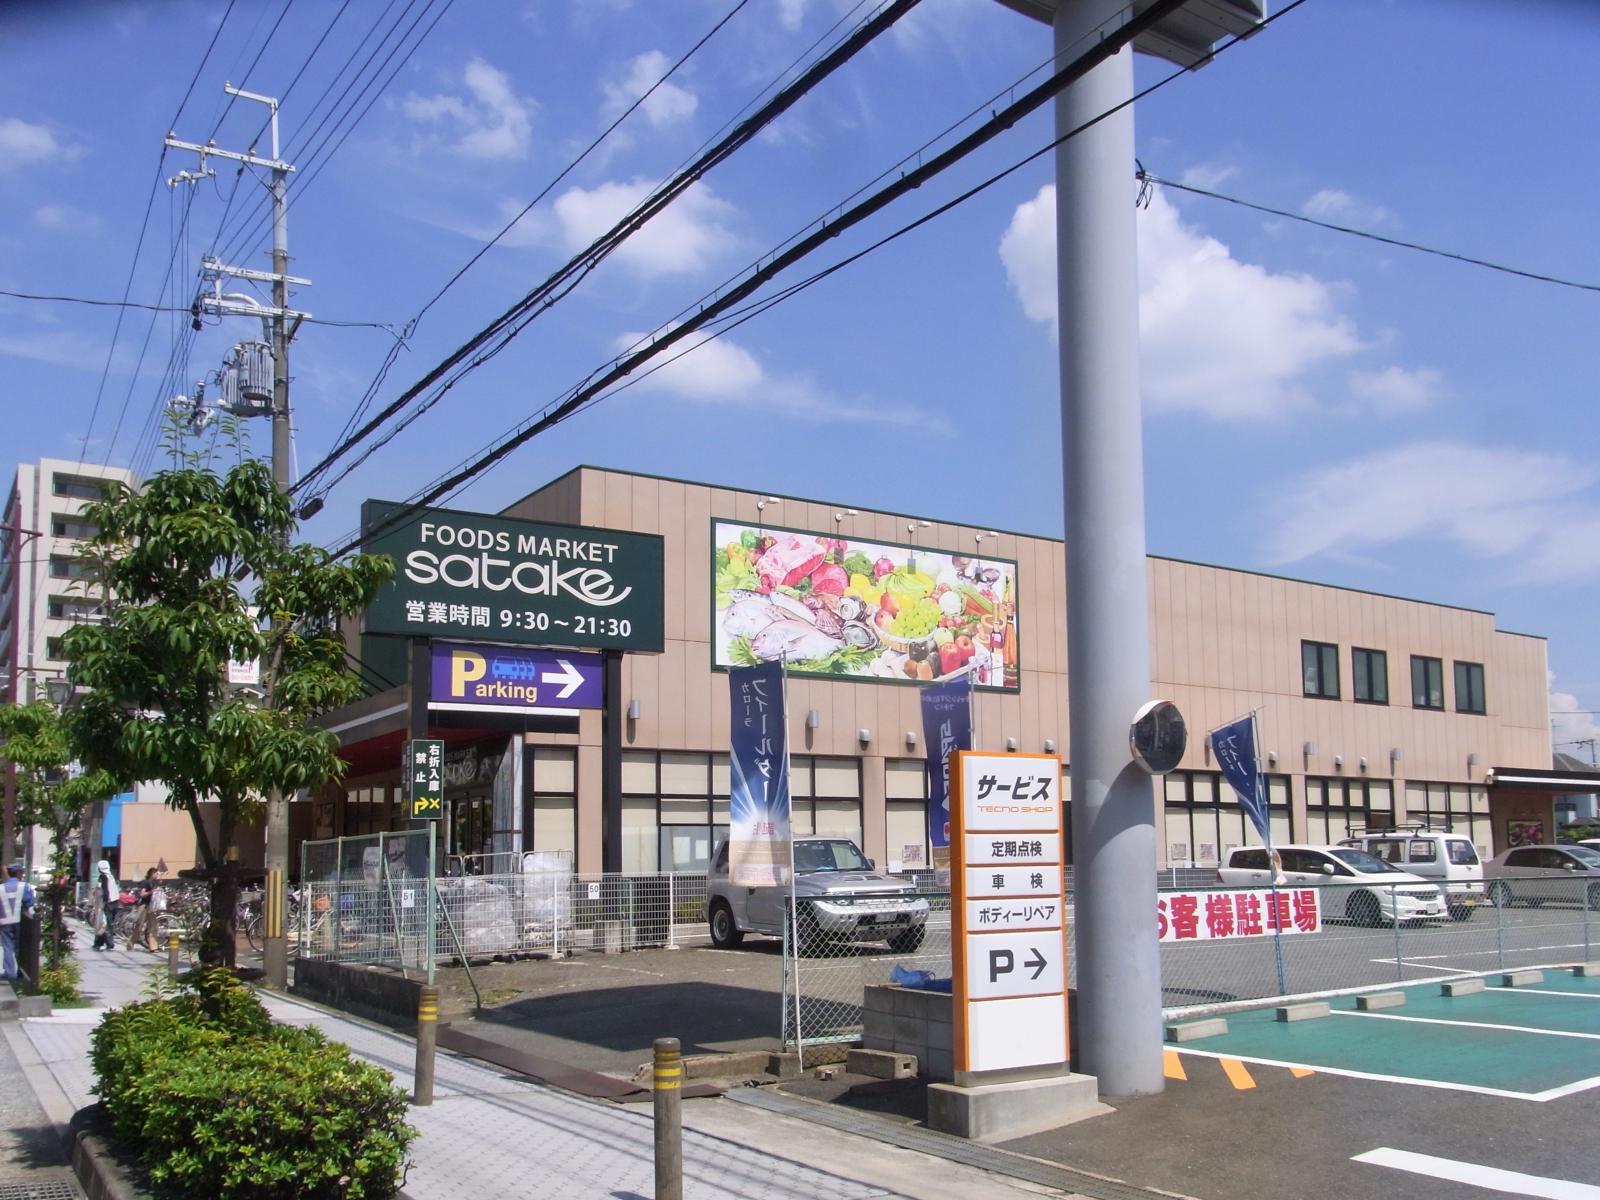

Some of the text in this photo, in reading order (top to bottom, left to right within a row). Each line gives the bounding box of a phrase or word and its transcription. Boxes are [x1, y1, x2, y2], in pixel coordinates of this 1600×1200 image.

[421, 522, 619, 563] FOODS MARKET
[404, 550, 633, 607] satake
[405, 600, 491, 628] 営業時間
[451, 650, 538, 703] Parking
[415, 752, 427, 783] 禁止
[428, 744, 441, 792] 右折入庫
[977, 775, 1053, 801] サービス
[991, 841, 1042, 858] 定期点検
[403, 892, 414, 901] 51
[589, 884, 599, 893] 50
[979, 905, 1056, 924] ボディーリペア
[989, 949, 1015, 983] P
